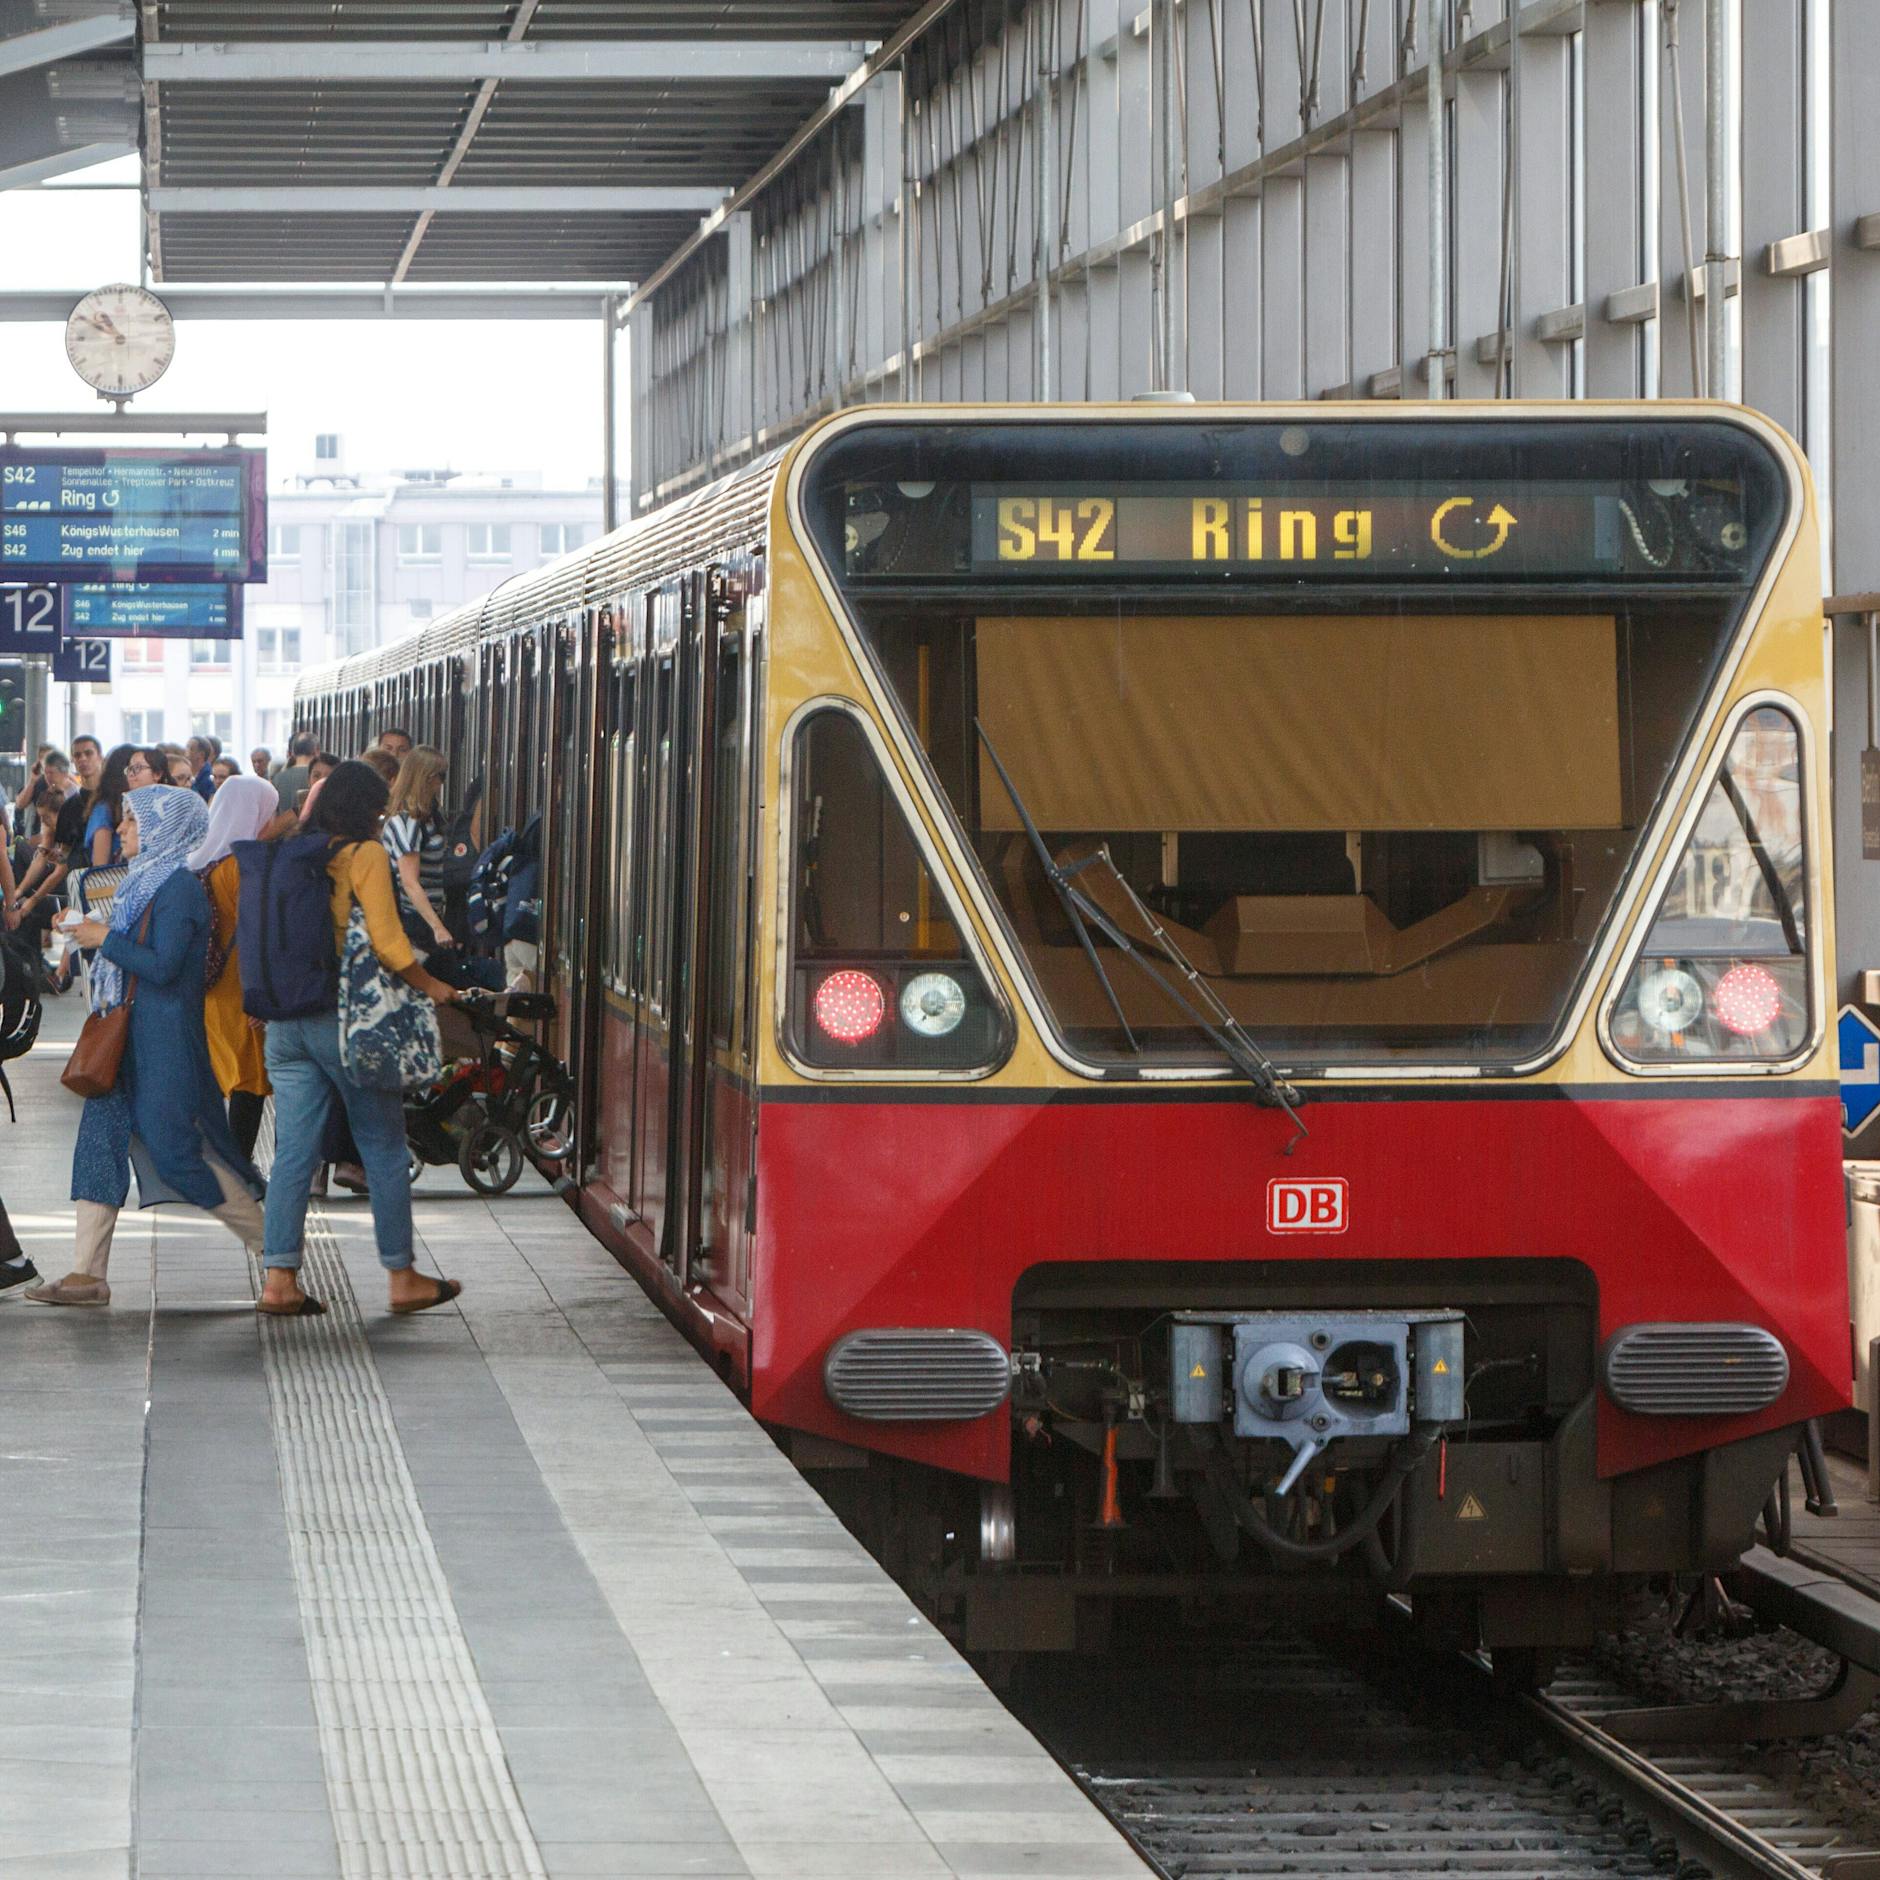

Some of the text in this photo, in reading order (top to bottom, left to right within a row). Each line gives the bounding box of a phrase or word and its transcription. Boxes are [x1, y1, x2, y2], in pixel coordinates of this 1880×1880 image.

[4, 466, 36, 484] S42
[62, 467, 105, 477] Tempelhof
[61, 477, 113, 486] Sonnenallee
[168, 477, 188, 487] Park
[61, 489, 96, 510] Ring
[4, 524, 27, 537] S46
[213, 529, 219, 538] 2
[221, 529, 240, 538] min
[998, 497, 1372, 560] S42 Ring
[4, 543, 240, 558] S42 Zug endet hier 4 min
[4, 588, 54, 632] 12
[74, 640, 107, 669] 12
[1279, 1188, 1338, 1223] DB
